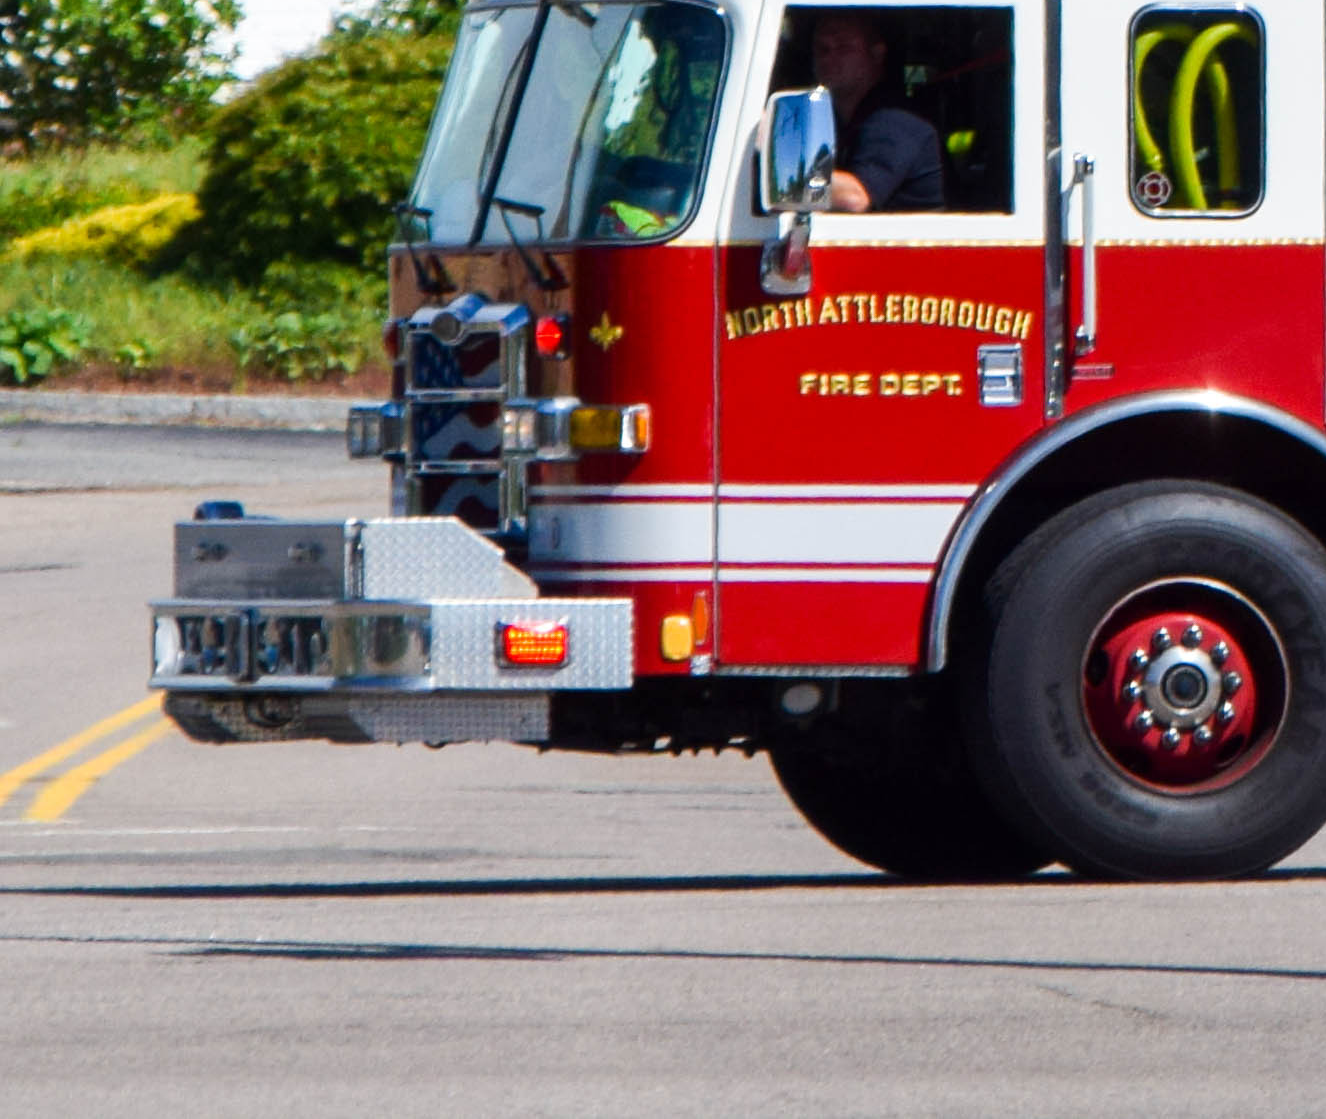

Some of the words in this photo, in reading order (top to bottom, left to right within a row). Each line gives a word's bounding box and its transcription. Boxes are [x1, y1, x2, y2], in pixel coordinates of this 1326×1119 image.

[725, 298, 814, 340] NORTH
[818, 294, 1034, 340] ATTLEBOROUGH
[800, 374, 872, 396] FIRE
[879, 374, 963, 396] DEPT.
